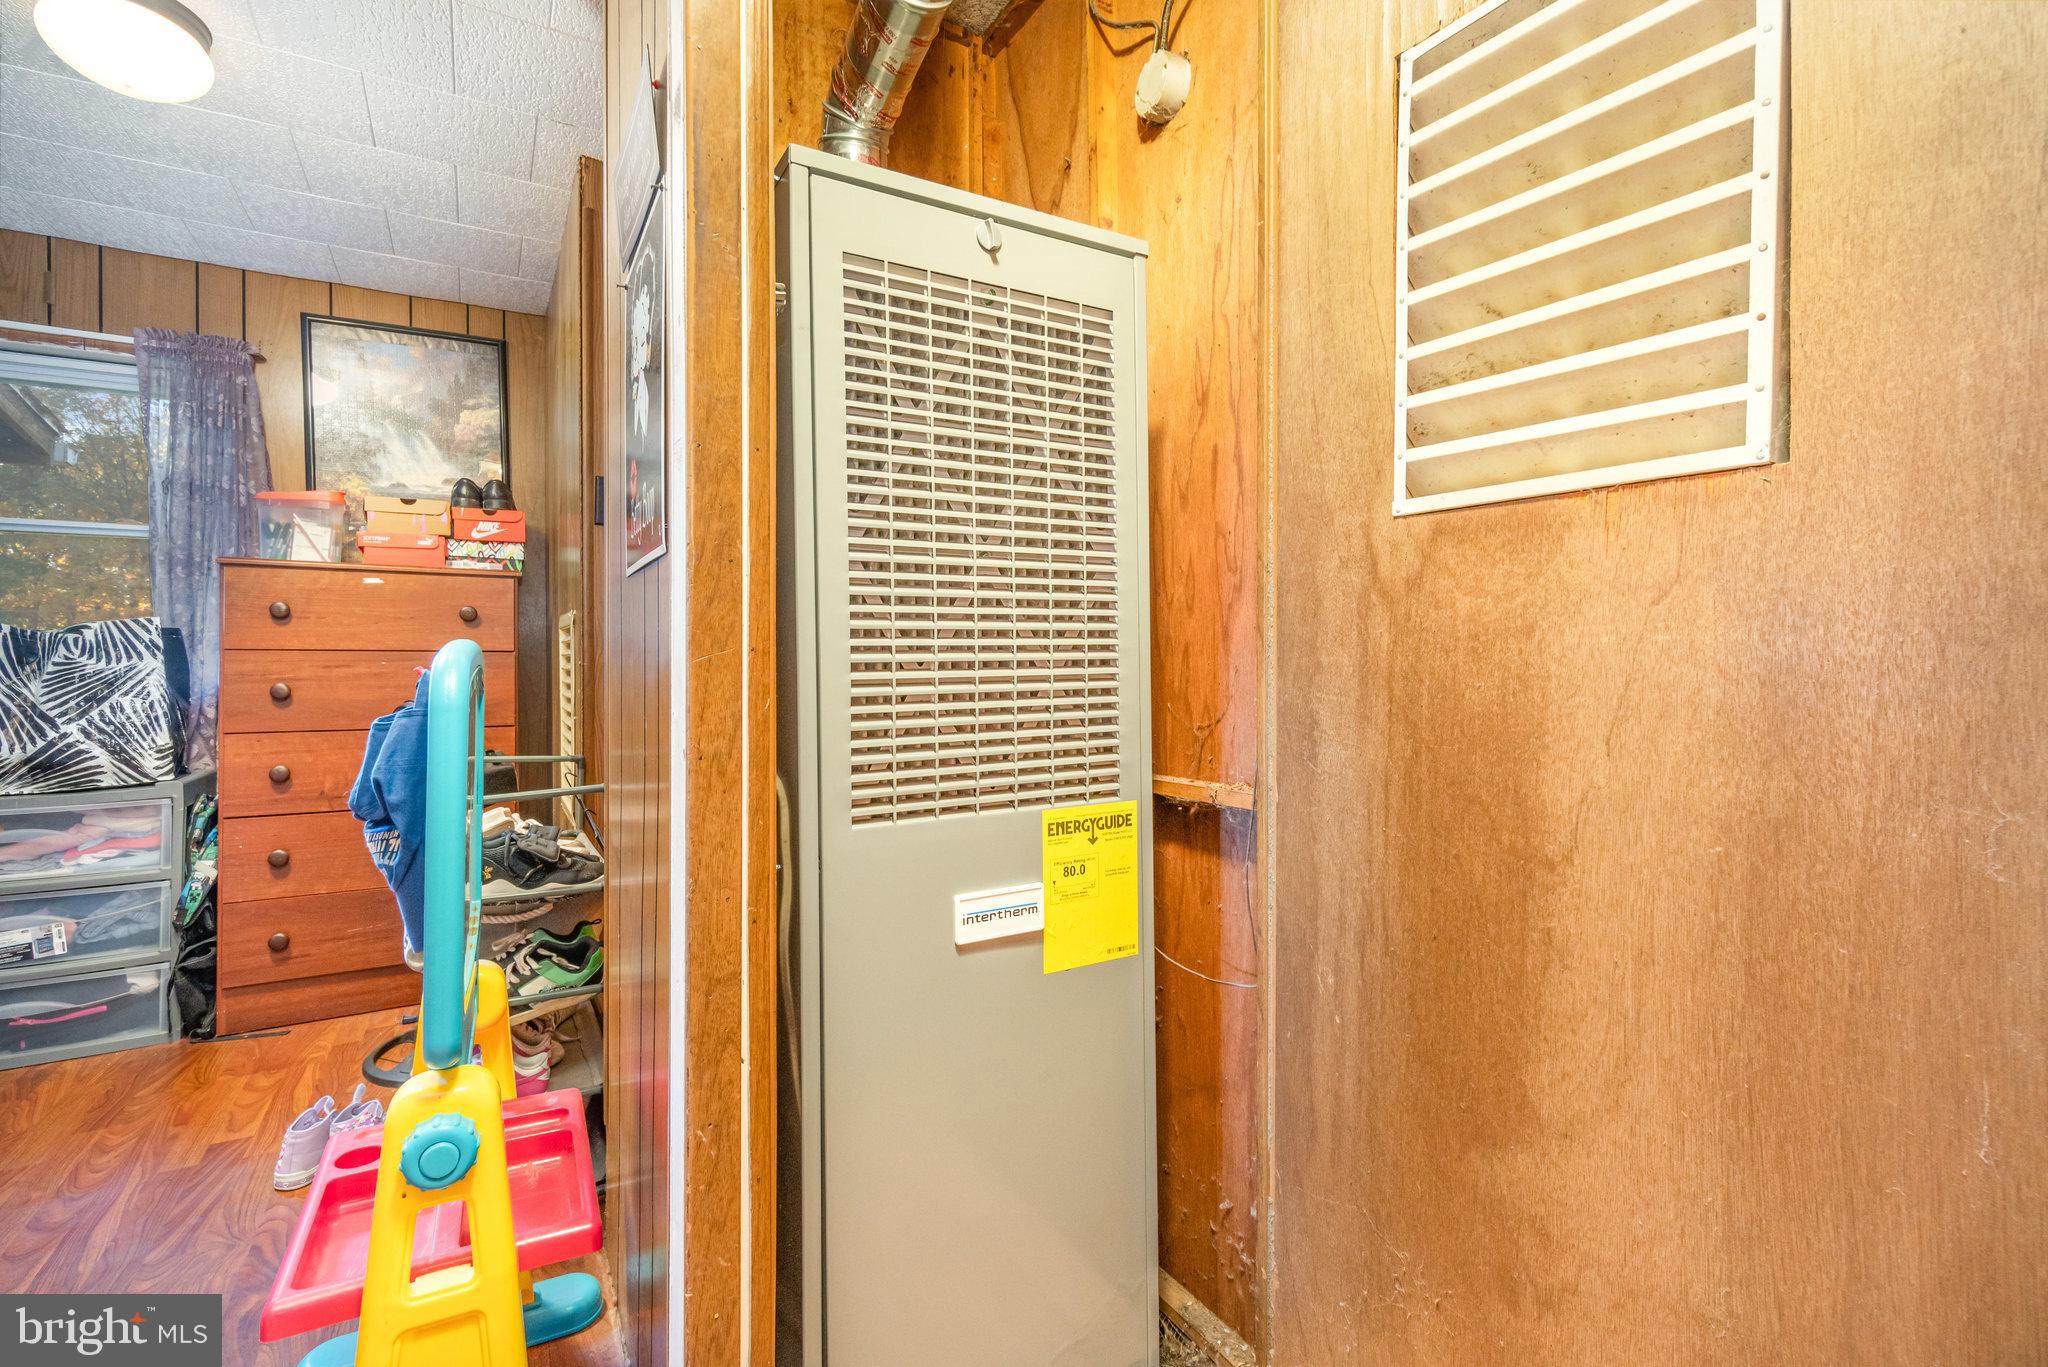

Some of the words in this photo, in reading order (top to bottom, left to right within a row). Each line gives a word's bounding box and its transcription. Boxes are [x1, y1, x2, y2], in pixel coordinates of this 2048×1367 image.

[476, 521, 501, 532] NIKE
[1047, 813, 1133, 837] ENERGYGUIDE
[1063, 864, 1086, 878] 80.0
[962, 904, 1038, 926] intertherm
